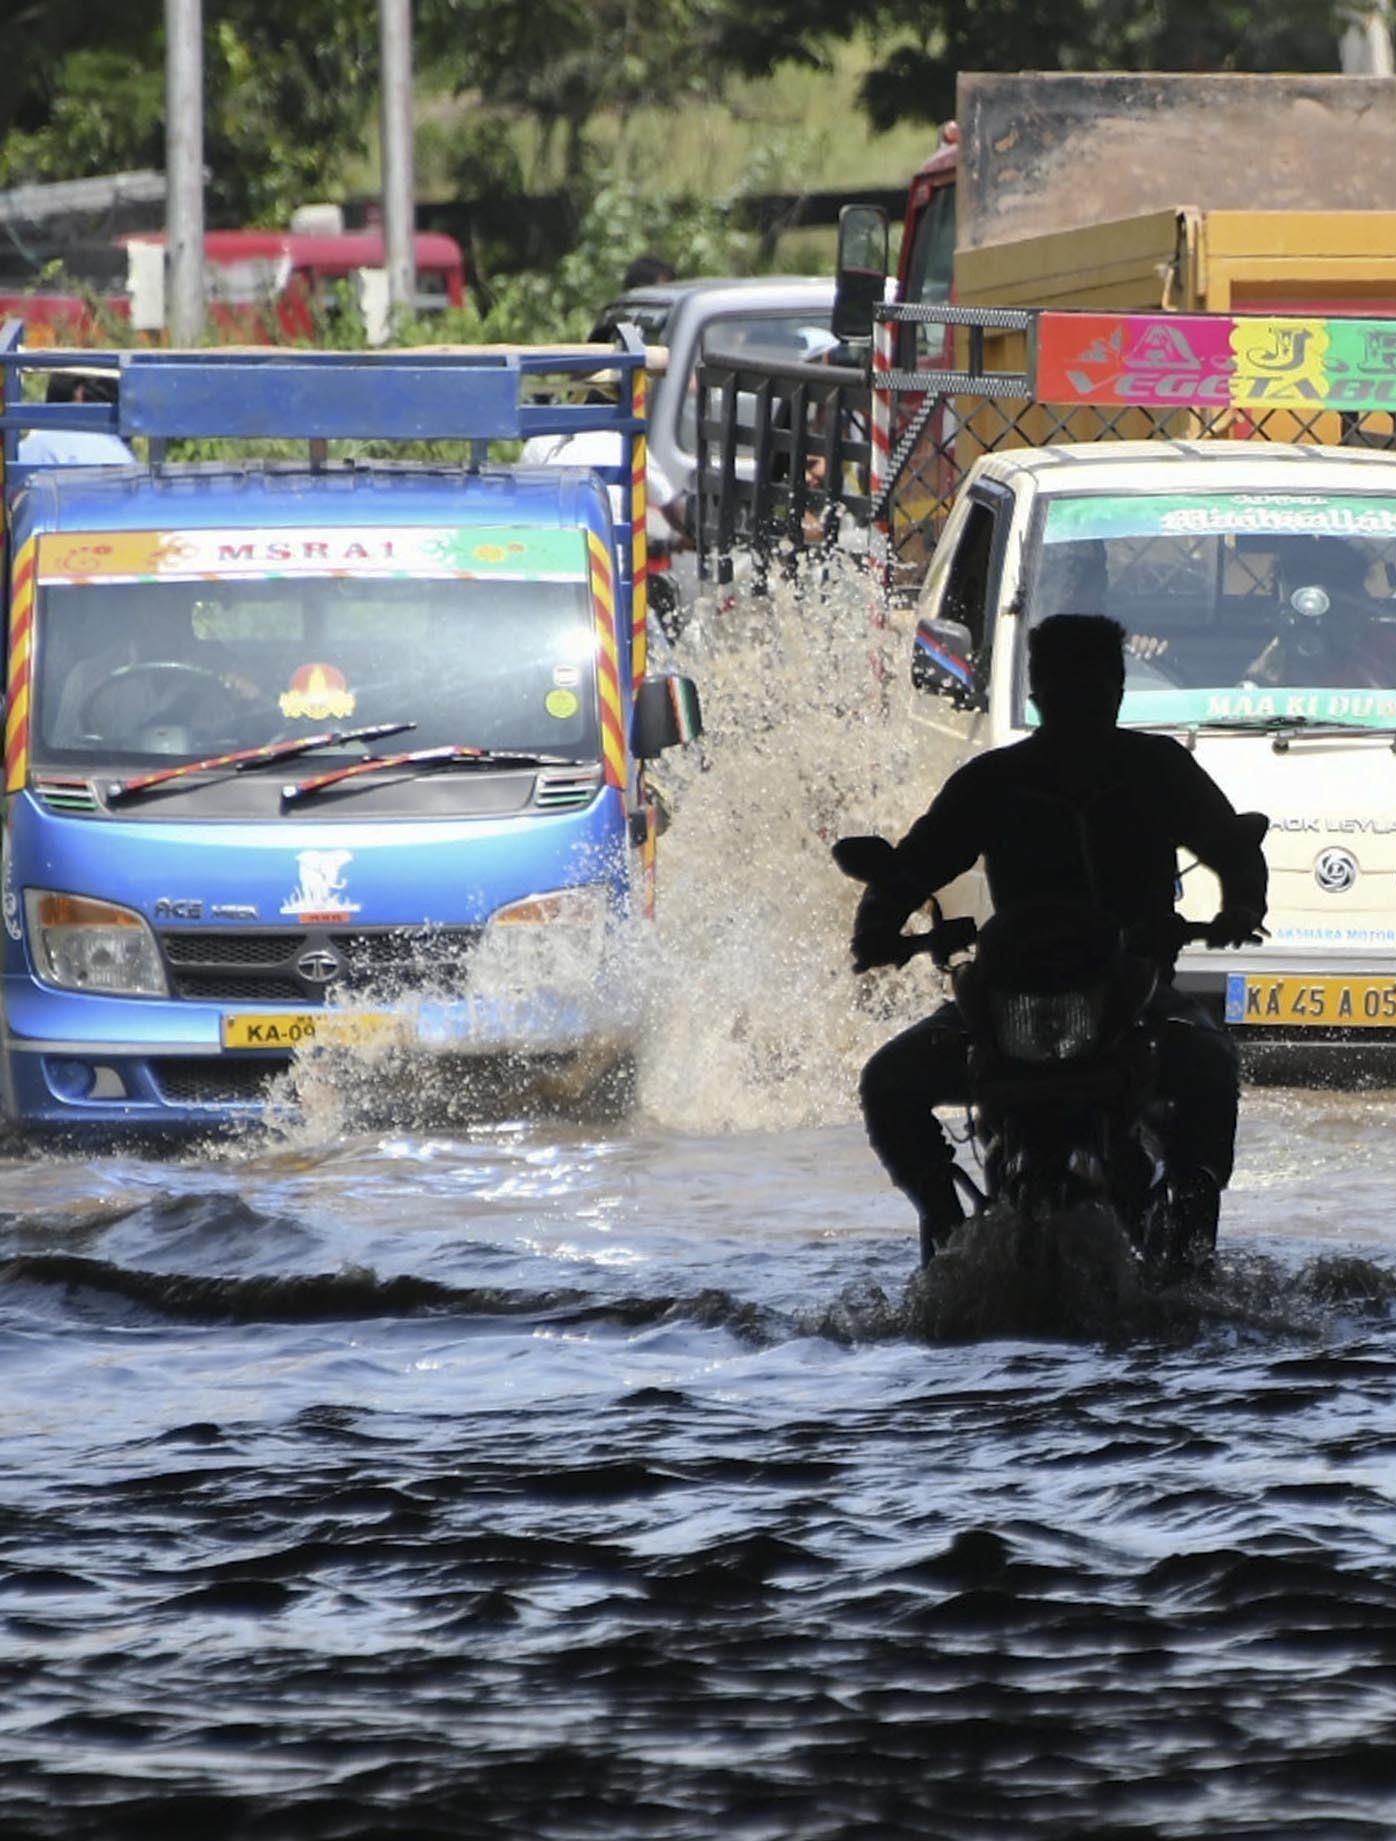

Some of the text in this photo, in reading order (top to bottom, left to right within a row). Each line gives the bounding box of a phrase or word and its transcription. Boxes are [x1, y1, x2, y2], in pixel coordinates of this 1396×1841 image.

[1248, 986, 1280, 1016] KA
[1291, 988, 1324, 1016] 45
[1339, 988, 1352, 1018] A
